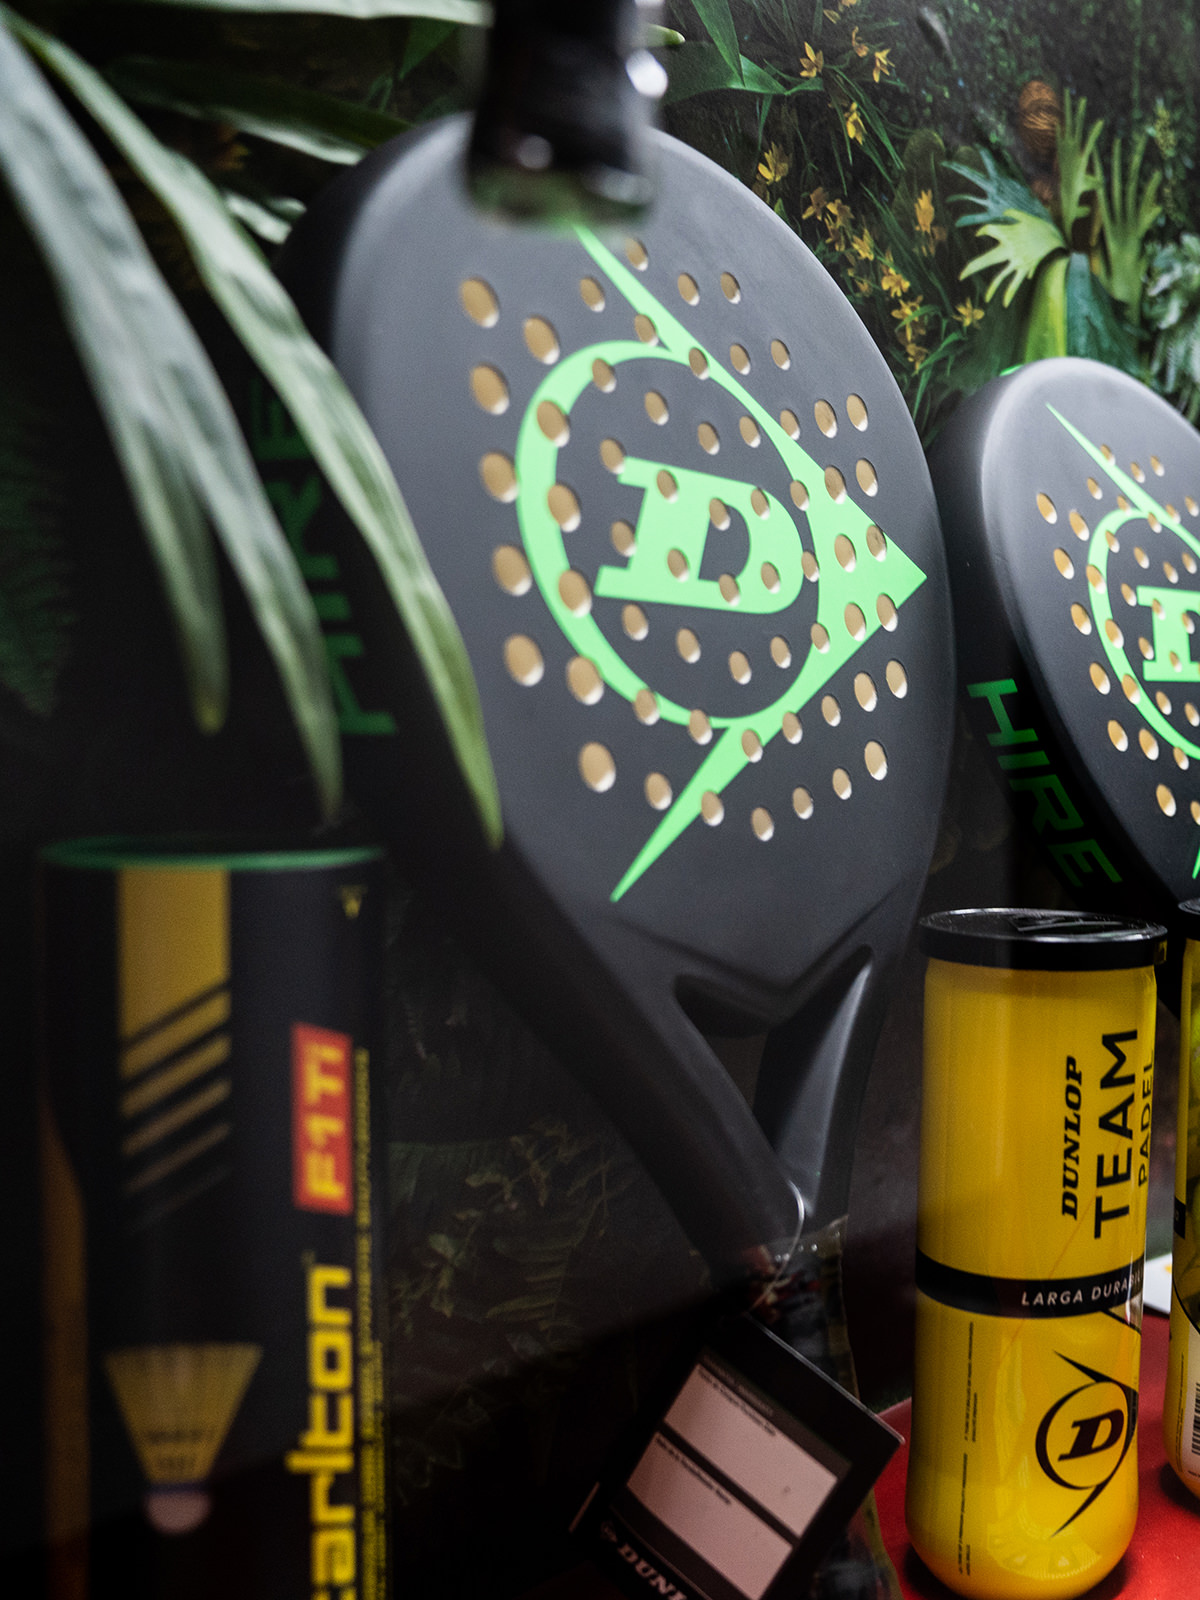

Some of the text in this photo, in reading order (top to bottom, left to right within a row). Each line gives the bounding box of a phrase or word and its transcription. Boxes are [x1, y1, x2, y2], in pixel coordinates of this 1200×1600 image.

[966, 678, 1124, 888] HIRE
[1061, 1055, 1083, 1221] DUNLOP
[1094, 1029, 1138, 1239] TEAM
[1138, 1050, 1154, 1187] PADEL
[1021, 1289, 1083, 1307] LARGA
[1058, 1409, 1125, 1461] D
